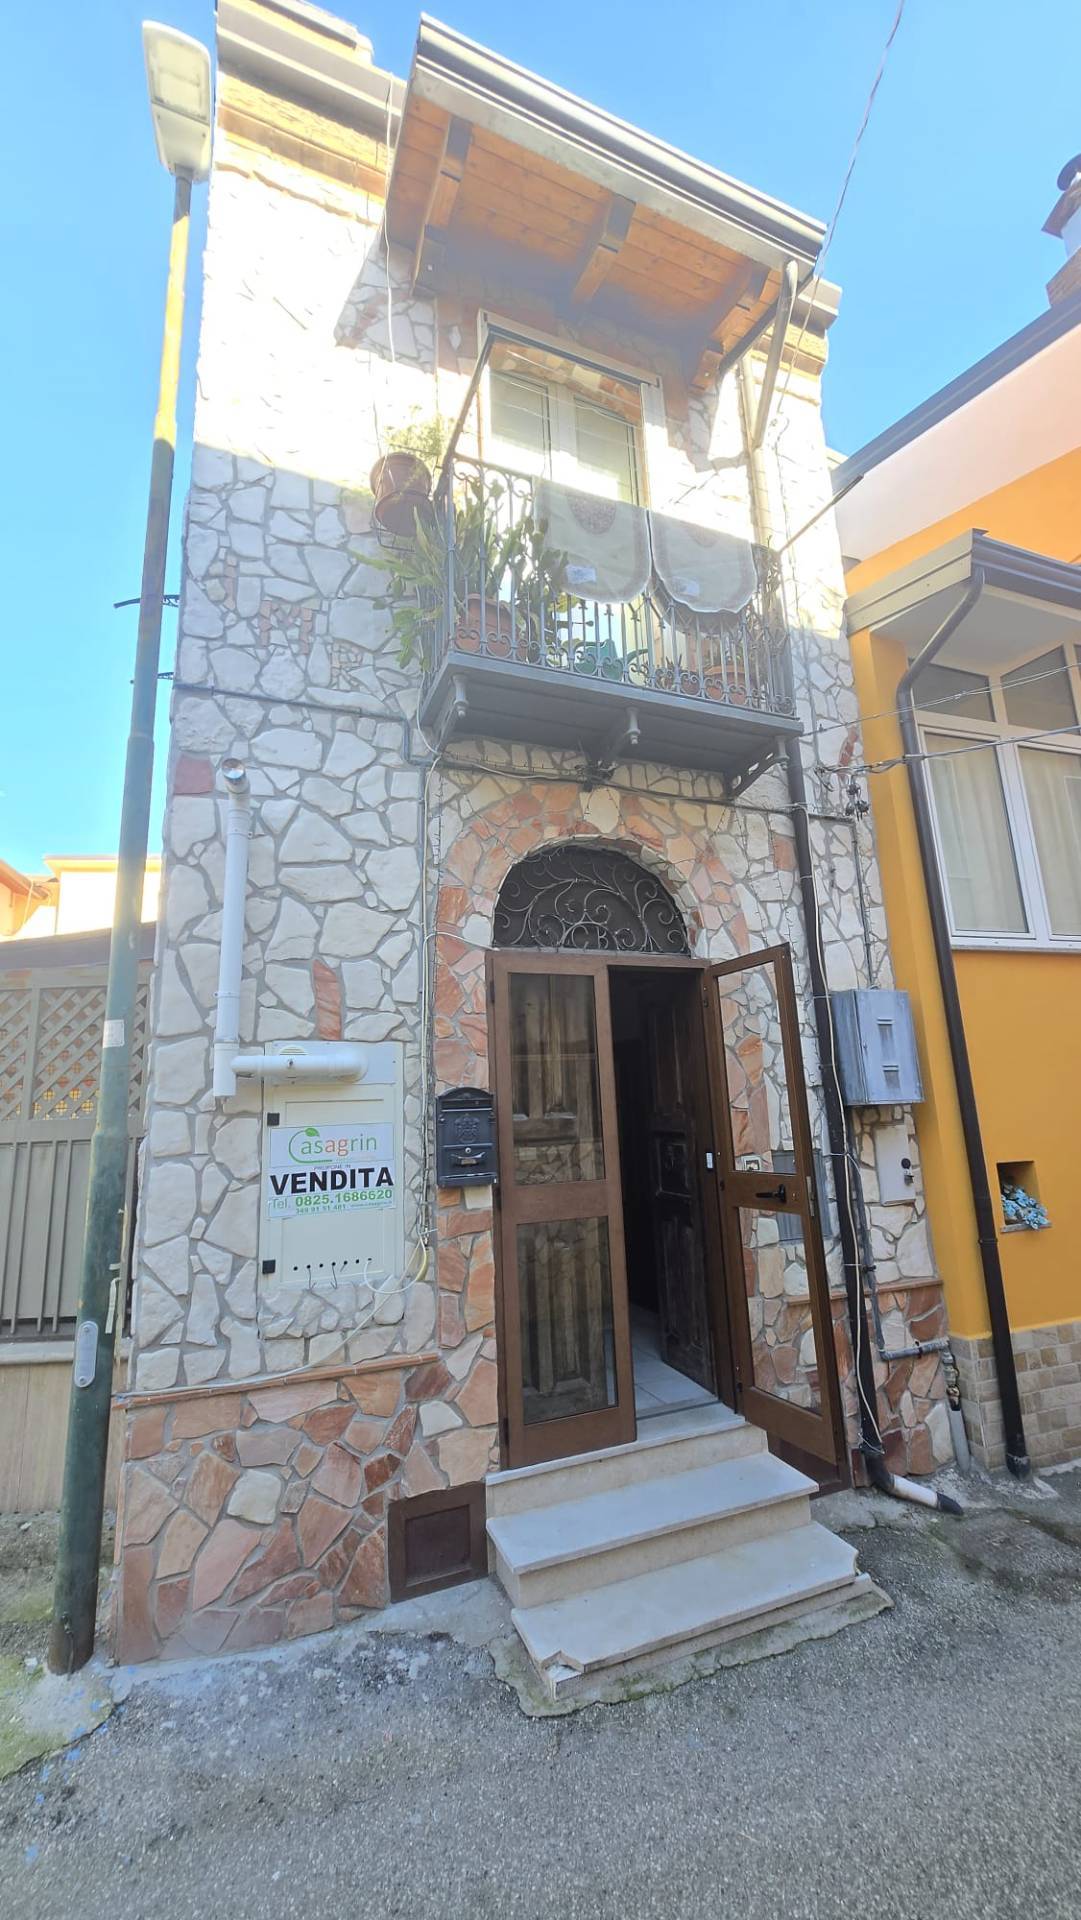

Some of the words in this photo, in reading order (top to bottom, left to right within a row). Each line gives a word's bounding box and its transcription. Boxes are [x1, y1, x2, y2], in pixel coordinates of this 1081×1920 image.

[288, 1127, 377, 1164] Casagrin
[270, 1166, 394, 1196] VENDITA
[295, 1189, 393, 1207] 0825.1686620
